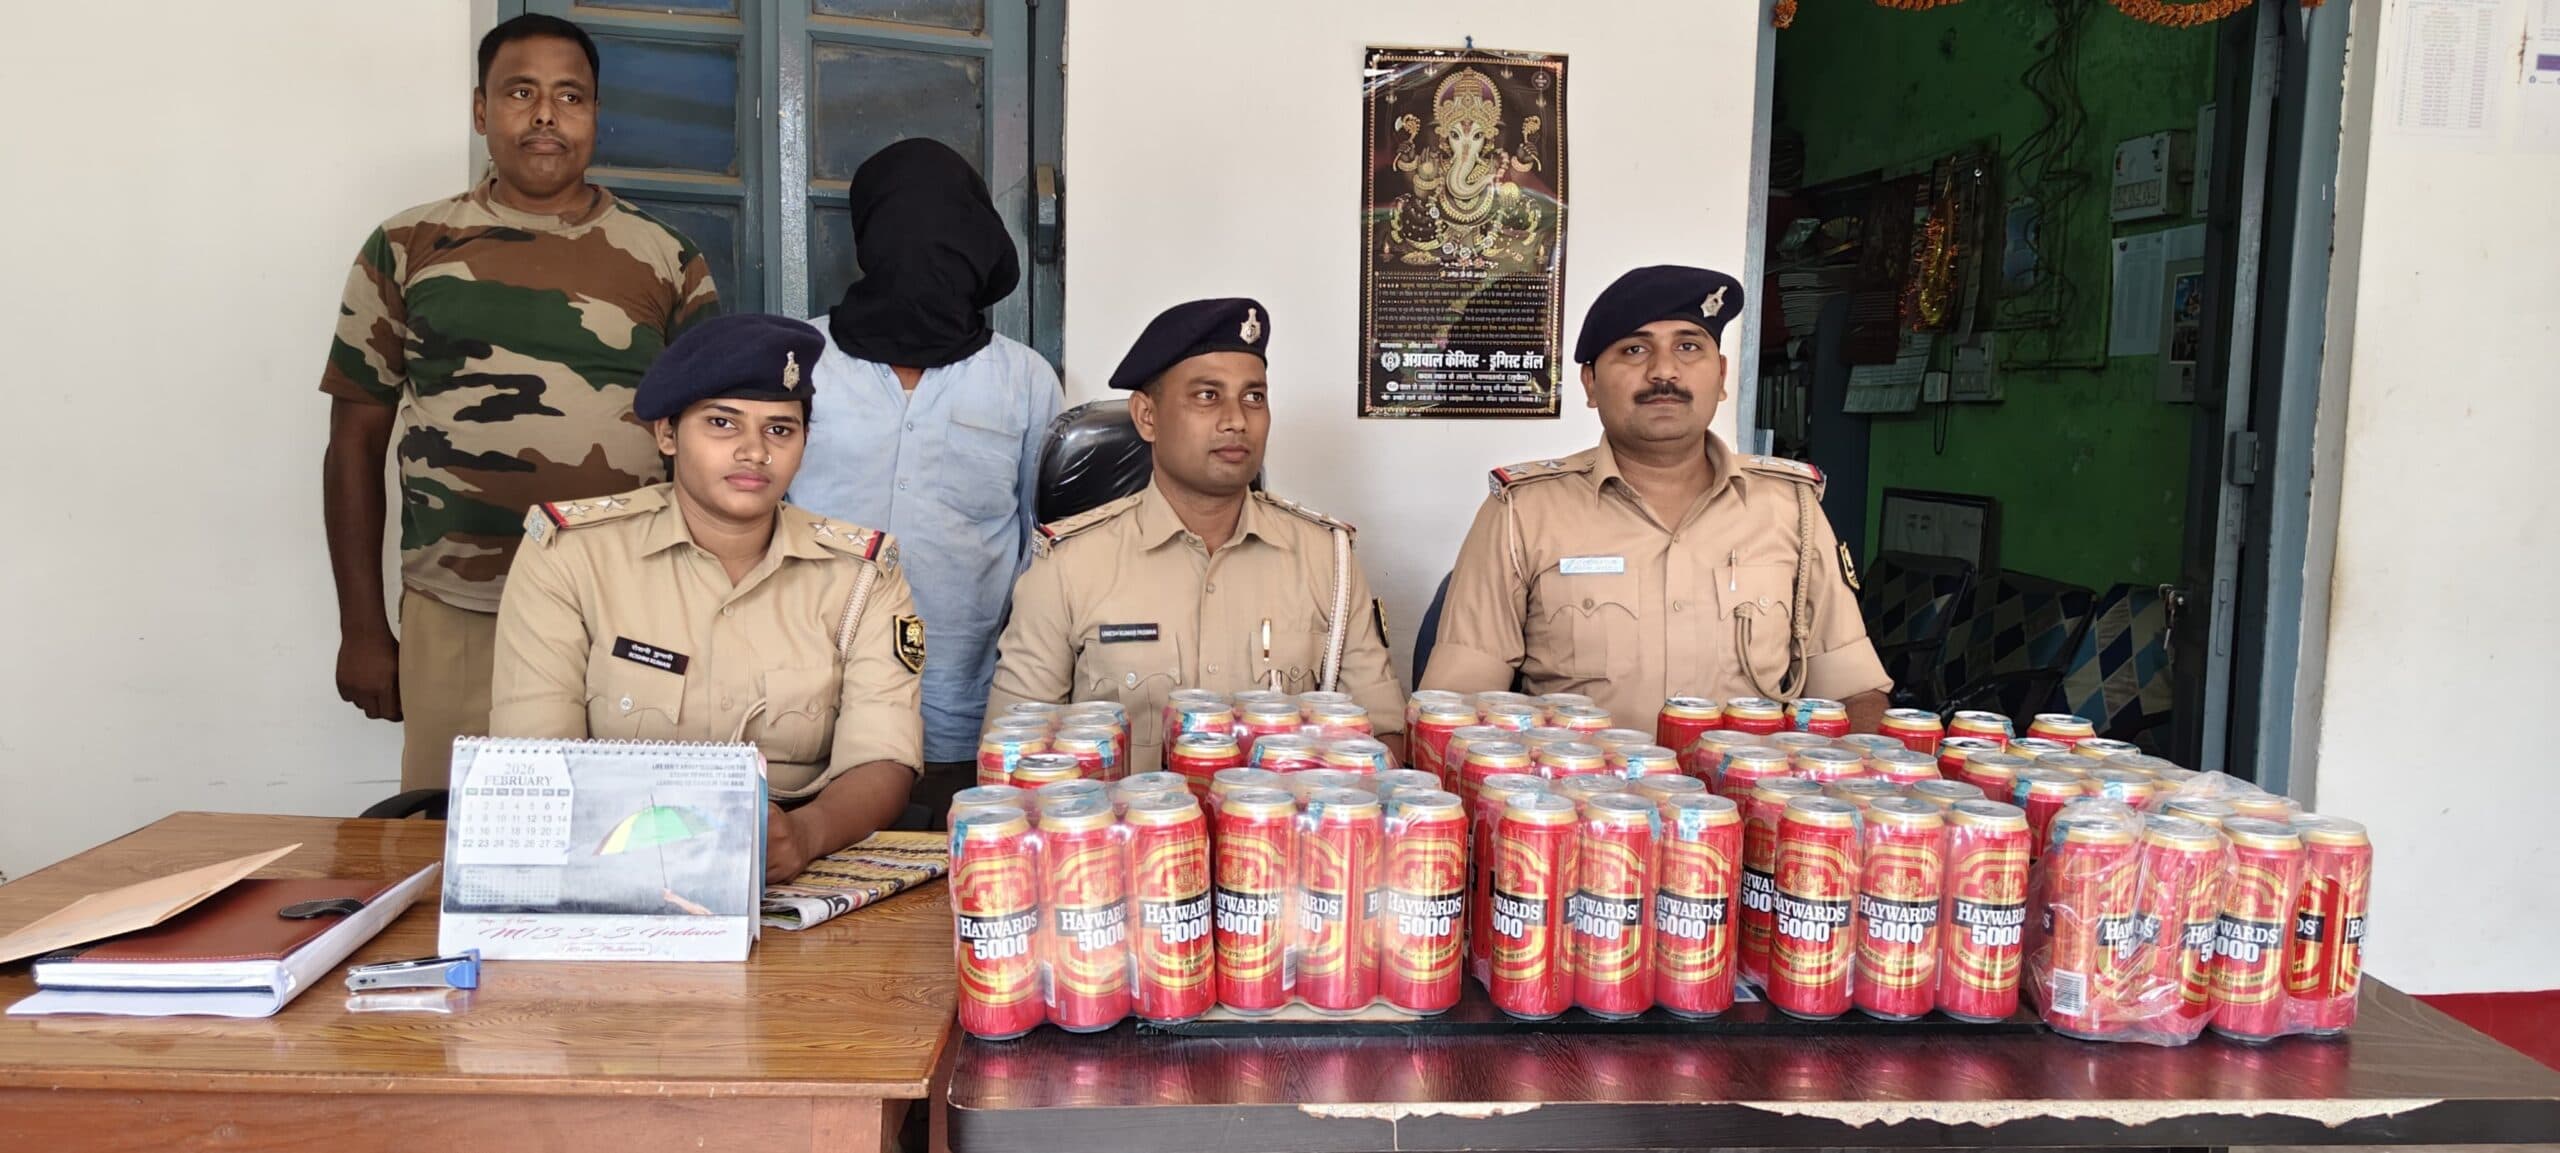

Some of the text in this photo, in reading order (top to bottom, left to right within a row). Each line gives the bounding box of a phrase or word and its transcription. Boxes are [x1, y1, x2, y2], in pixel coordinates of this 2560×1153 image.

[1402, 352, 1443, 368] अग्रवाल
[1445, 350, 1479, 368] केमिस्ट
[484, 776, 552, 786] FEBRUARY
[504, 763, 535, 775] 2026
[478, 840, 489, 848] 23
[1144, 897, 1209, 923] HAYWARD
[1388, 891, 1463, 916] HAYWARDS
[1742, 887, 1772, 912] 500
[1773, 890, 1847, 921] HAYWARDS
[1859, 894, 1937, 922] HAYWARDS
[960, 911, 1038, 939] HAYWARDS
[1061, 903, 1127, 931] HAYWARD
[1217, 909, 1262, 935] 5000
[1400, 916, 1450, 936] 5000
[1494, 912, 1523, 938] 000
[1657, 912, 1706, 940] 5000
[1957, 902, 2025, 926] HAYWARD
[1078, 921, 1125, 951] 5000
[1161, 915, 1208, 944] 5000
[1778, 913, 1830, 942] 5000
[1869, 918, 1923, 943] 5000
[1972, 924, 2021, 945] 5000
[974, 933, 1028, 960] 5000
[2216, 936, 2259, 962] 000
